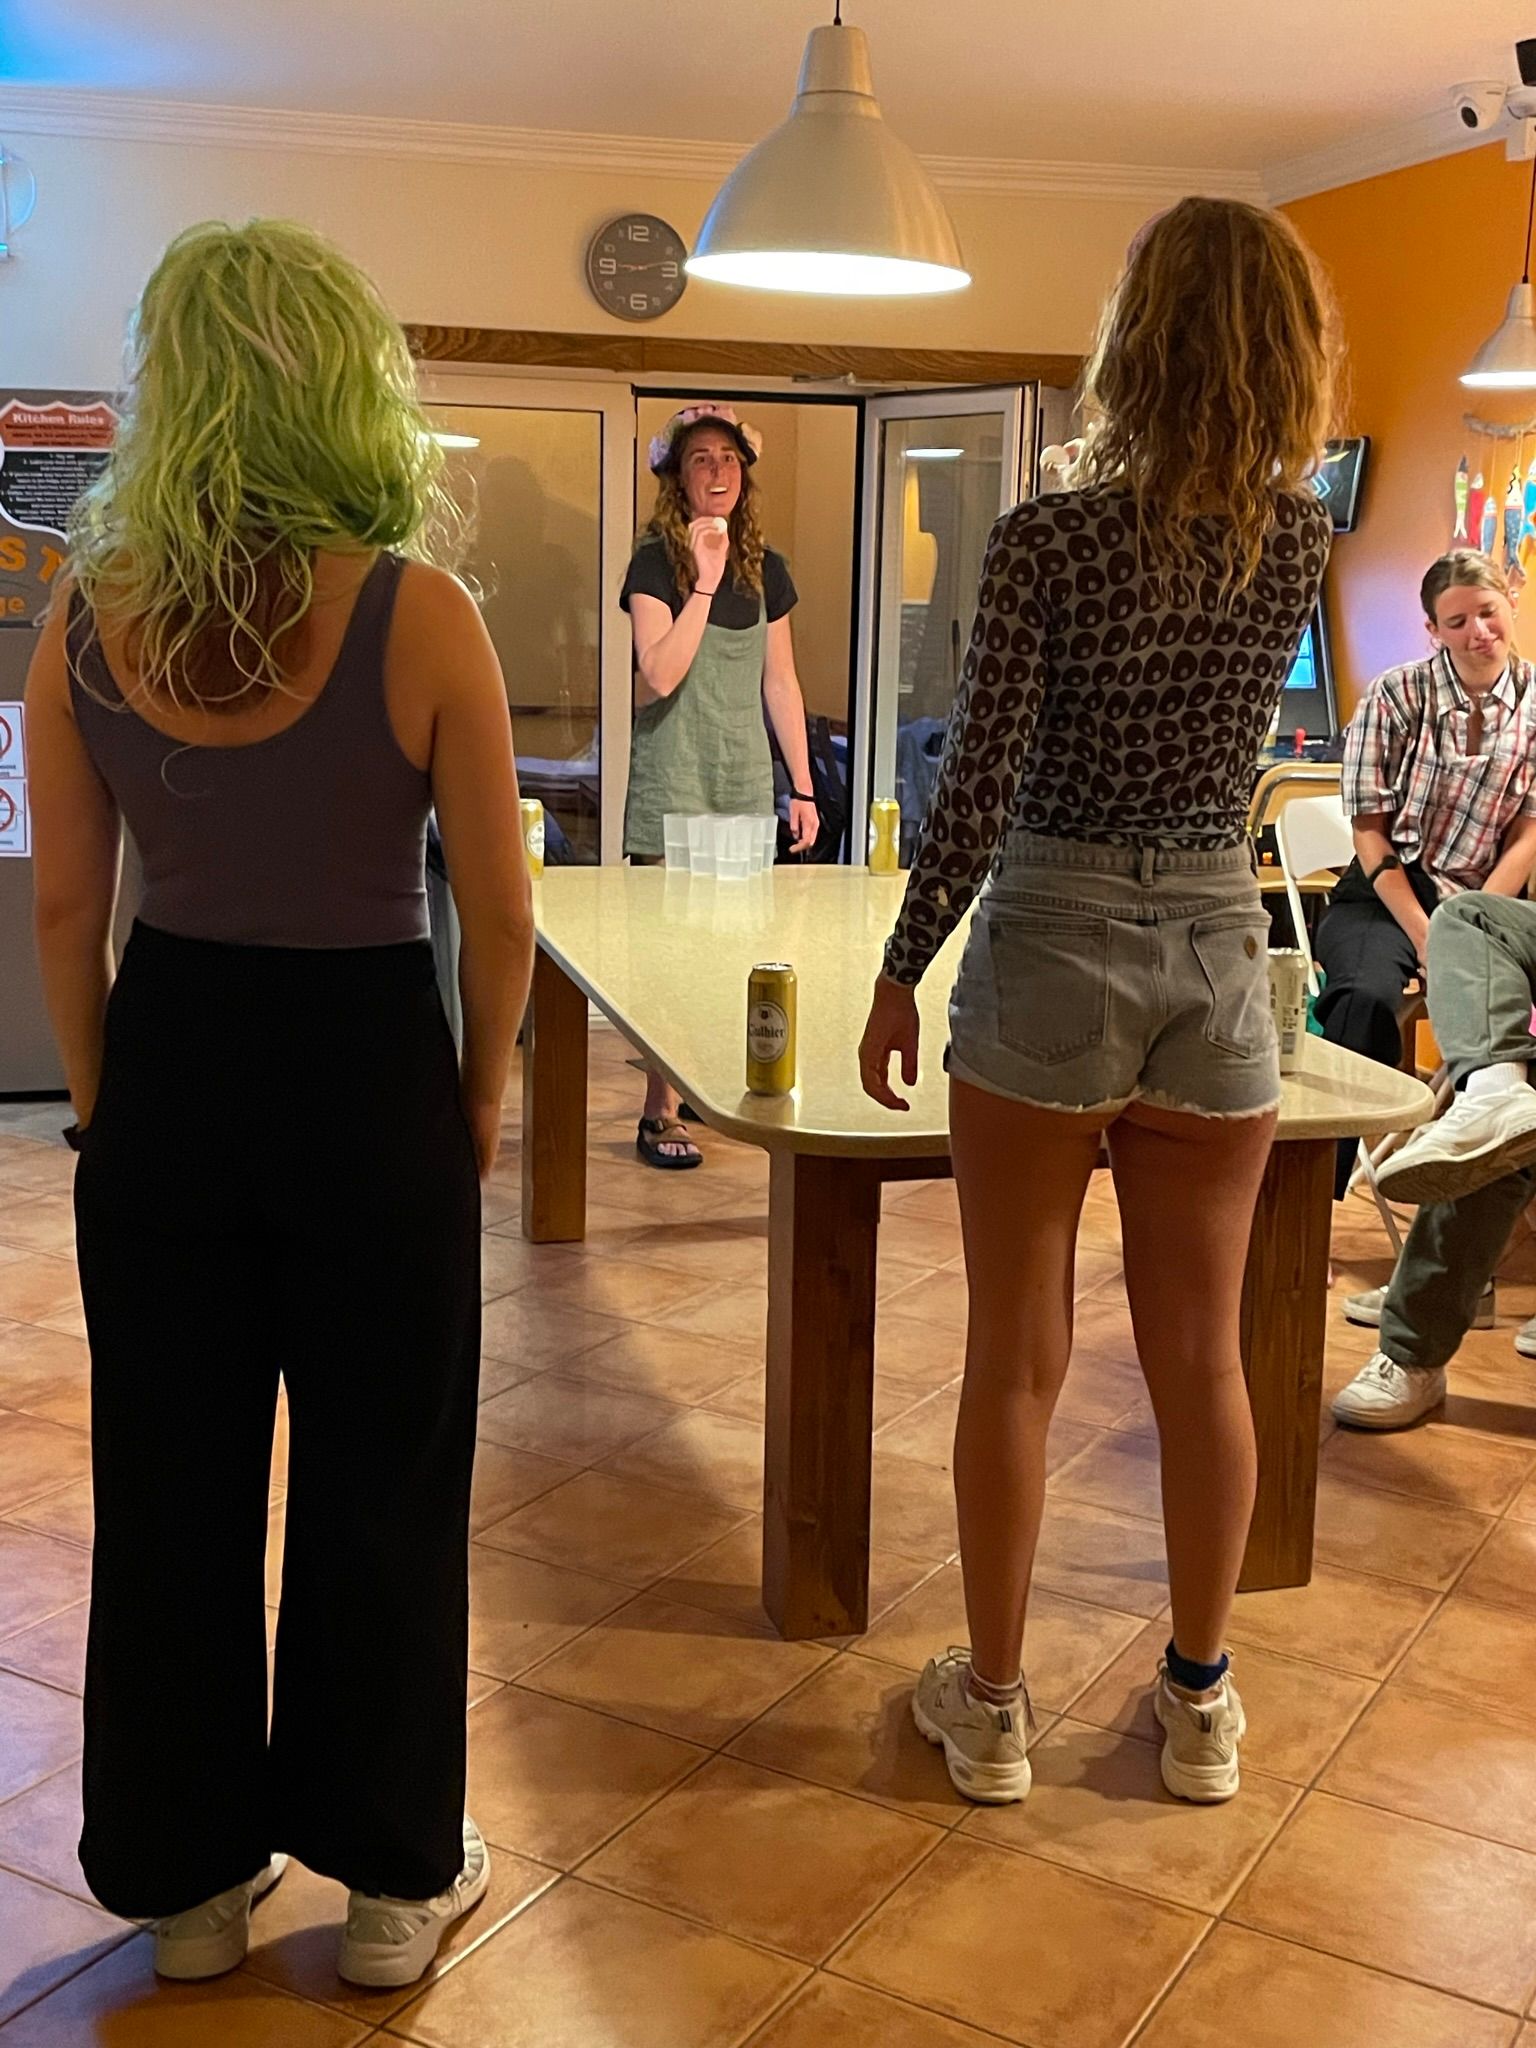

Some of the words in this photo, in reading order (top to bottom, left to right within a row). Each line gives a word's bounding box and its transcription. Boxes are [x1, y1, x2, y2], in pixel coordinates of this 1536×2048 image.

[628, 225, 650, 242] 12
[599, 258, 616, 275] 9
[661, 261, 678, 278] 3
[630, 293, 647, 310] 6
[12, 413, 65, 425] Kitchen
[68, 414, 105, 425] Rules
